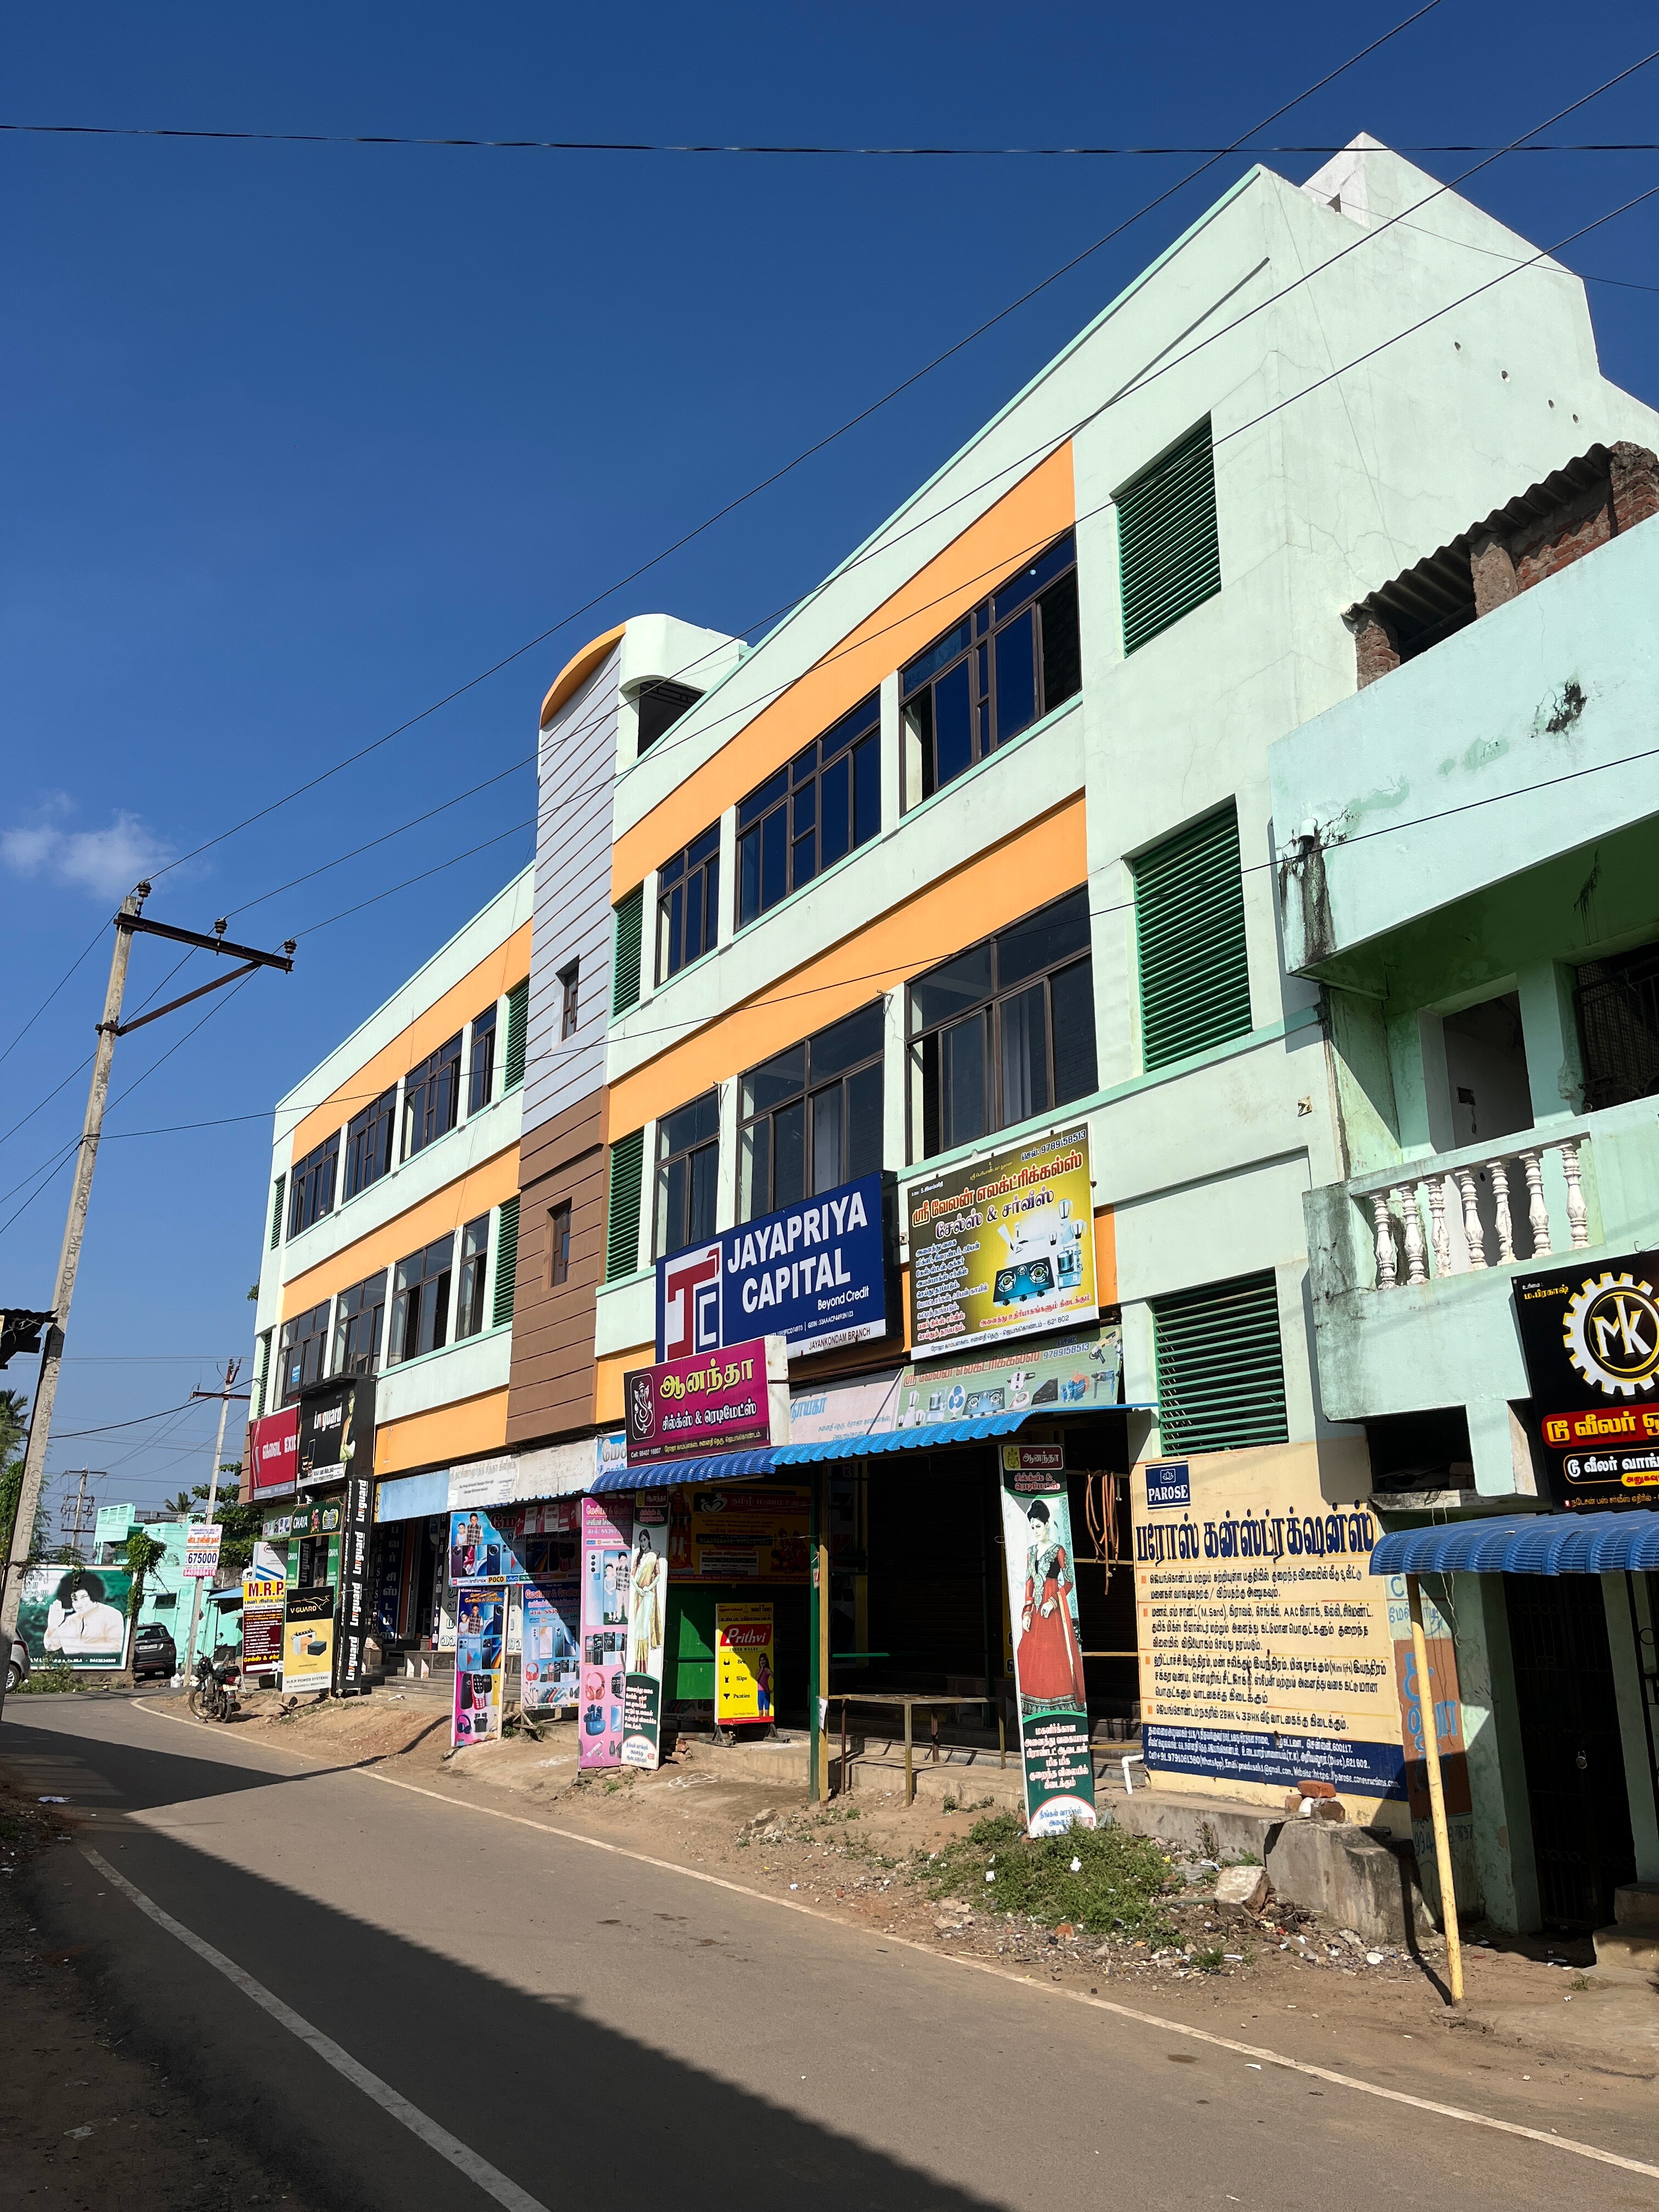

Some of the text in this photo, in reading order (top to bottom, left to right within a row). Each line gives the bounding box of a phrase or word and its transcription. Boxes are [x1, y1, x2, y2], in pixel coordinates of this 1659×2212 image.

[1041, 1130, 1086, 1154] 9789158513
[932, 1188, 975, 1217] வேலன்
[936, 1186, 1054, 1239] சேல்ஸ் & சர்வீஸ்
[727, 1192, 867, 1273] JAYAPRIYA
[742, 1248, 851, 1313] CAPITAL
[818, 1286, 870, 1310] Beyond Credit
[809, 1327, 871, 1350] JAYANKONDAM BRANCH
[1592, 1296, 1652, 1358] MK
[1043, 1343, 1090, 1360] 9789158513
[659, 1358, 754, 1399] ஆனந்தா
[313, 1402, 342, 1432] Livguard
[662, 1398, 757, 1431] சில்க்ஸ் & ரெடிமேட்ஸ்
[1575, 1410, 1636, 1436] வீலர்
[1023, 1451, 1059, 1464] ஆனந்தா
[1584, 1456, 1618, 1473] வீலர்
[356, 1480, 369, 1522] Livguard
[1148, 1485, 1188, 1502] PAROSE
[294, 1516, 308, 1529] OKAYA
[353, 1531, 365, 1575] Livguard
[1136, 1513, 1199, 1567] பரோஸ்
[188, 1553, 217, 1564] 675000
[249, 1582, 284, 1597] M.R.P.
[349, 1582, 363, 1626] Livguard
[1284, 1607, 1299, 1617] AAC
[725, 1628, 766, 1643] Prithvi
[346, 1636, 359, 1680] Livguard
